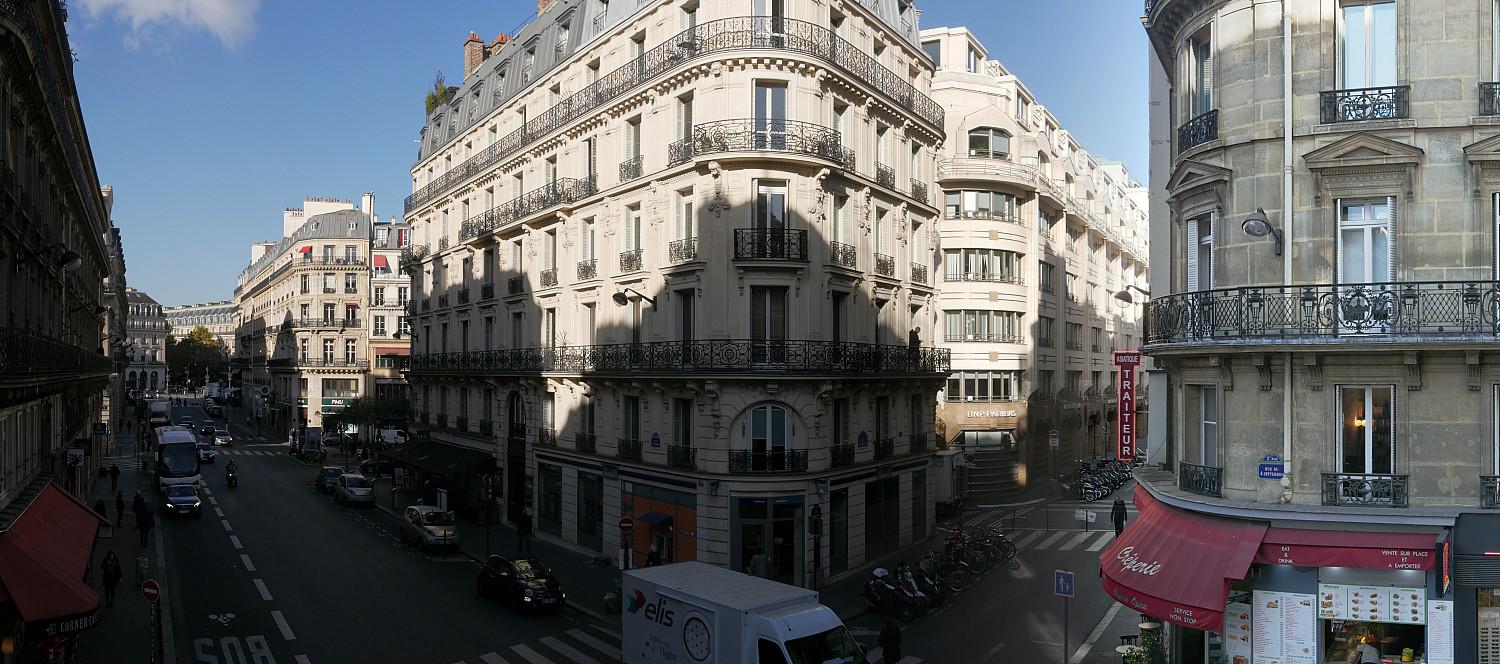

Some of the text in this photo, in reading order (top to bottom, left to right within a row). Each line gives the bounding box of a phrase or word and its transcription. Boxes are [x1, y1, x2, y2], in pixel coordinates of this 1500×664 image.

[1116, 355, 1138, 363] ASIATIQUE
[967, 410, 985, 418] BNP
[1122, 369, 1132, 456] TRAITEUR
[1116, 546, 1161, 575] Crêperie
[645, 598, 674, 627] elis
[1173, 607, 1193, 616] SERVICE
[1170, 614, 1197, 624] NON STOP
